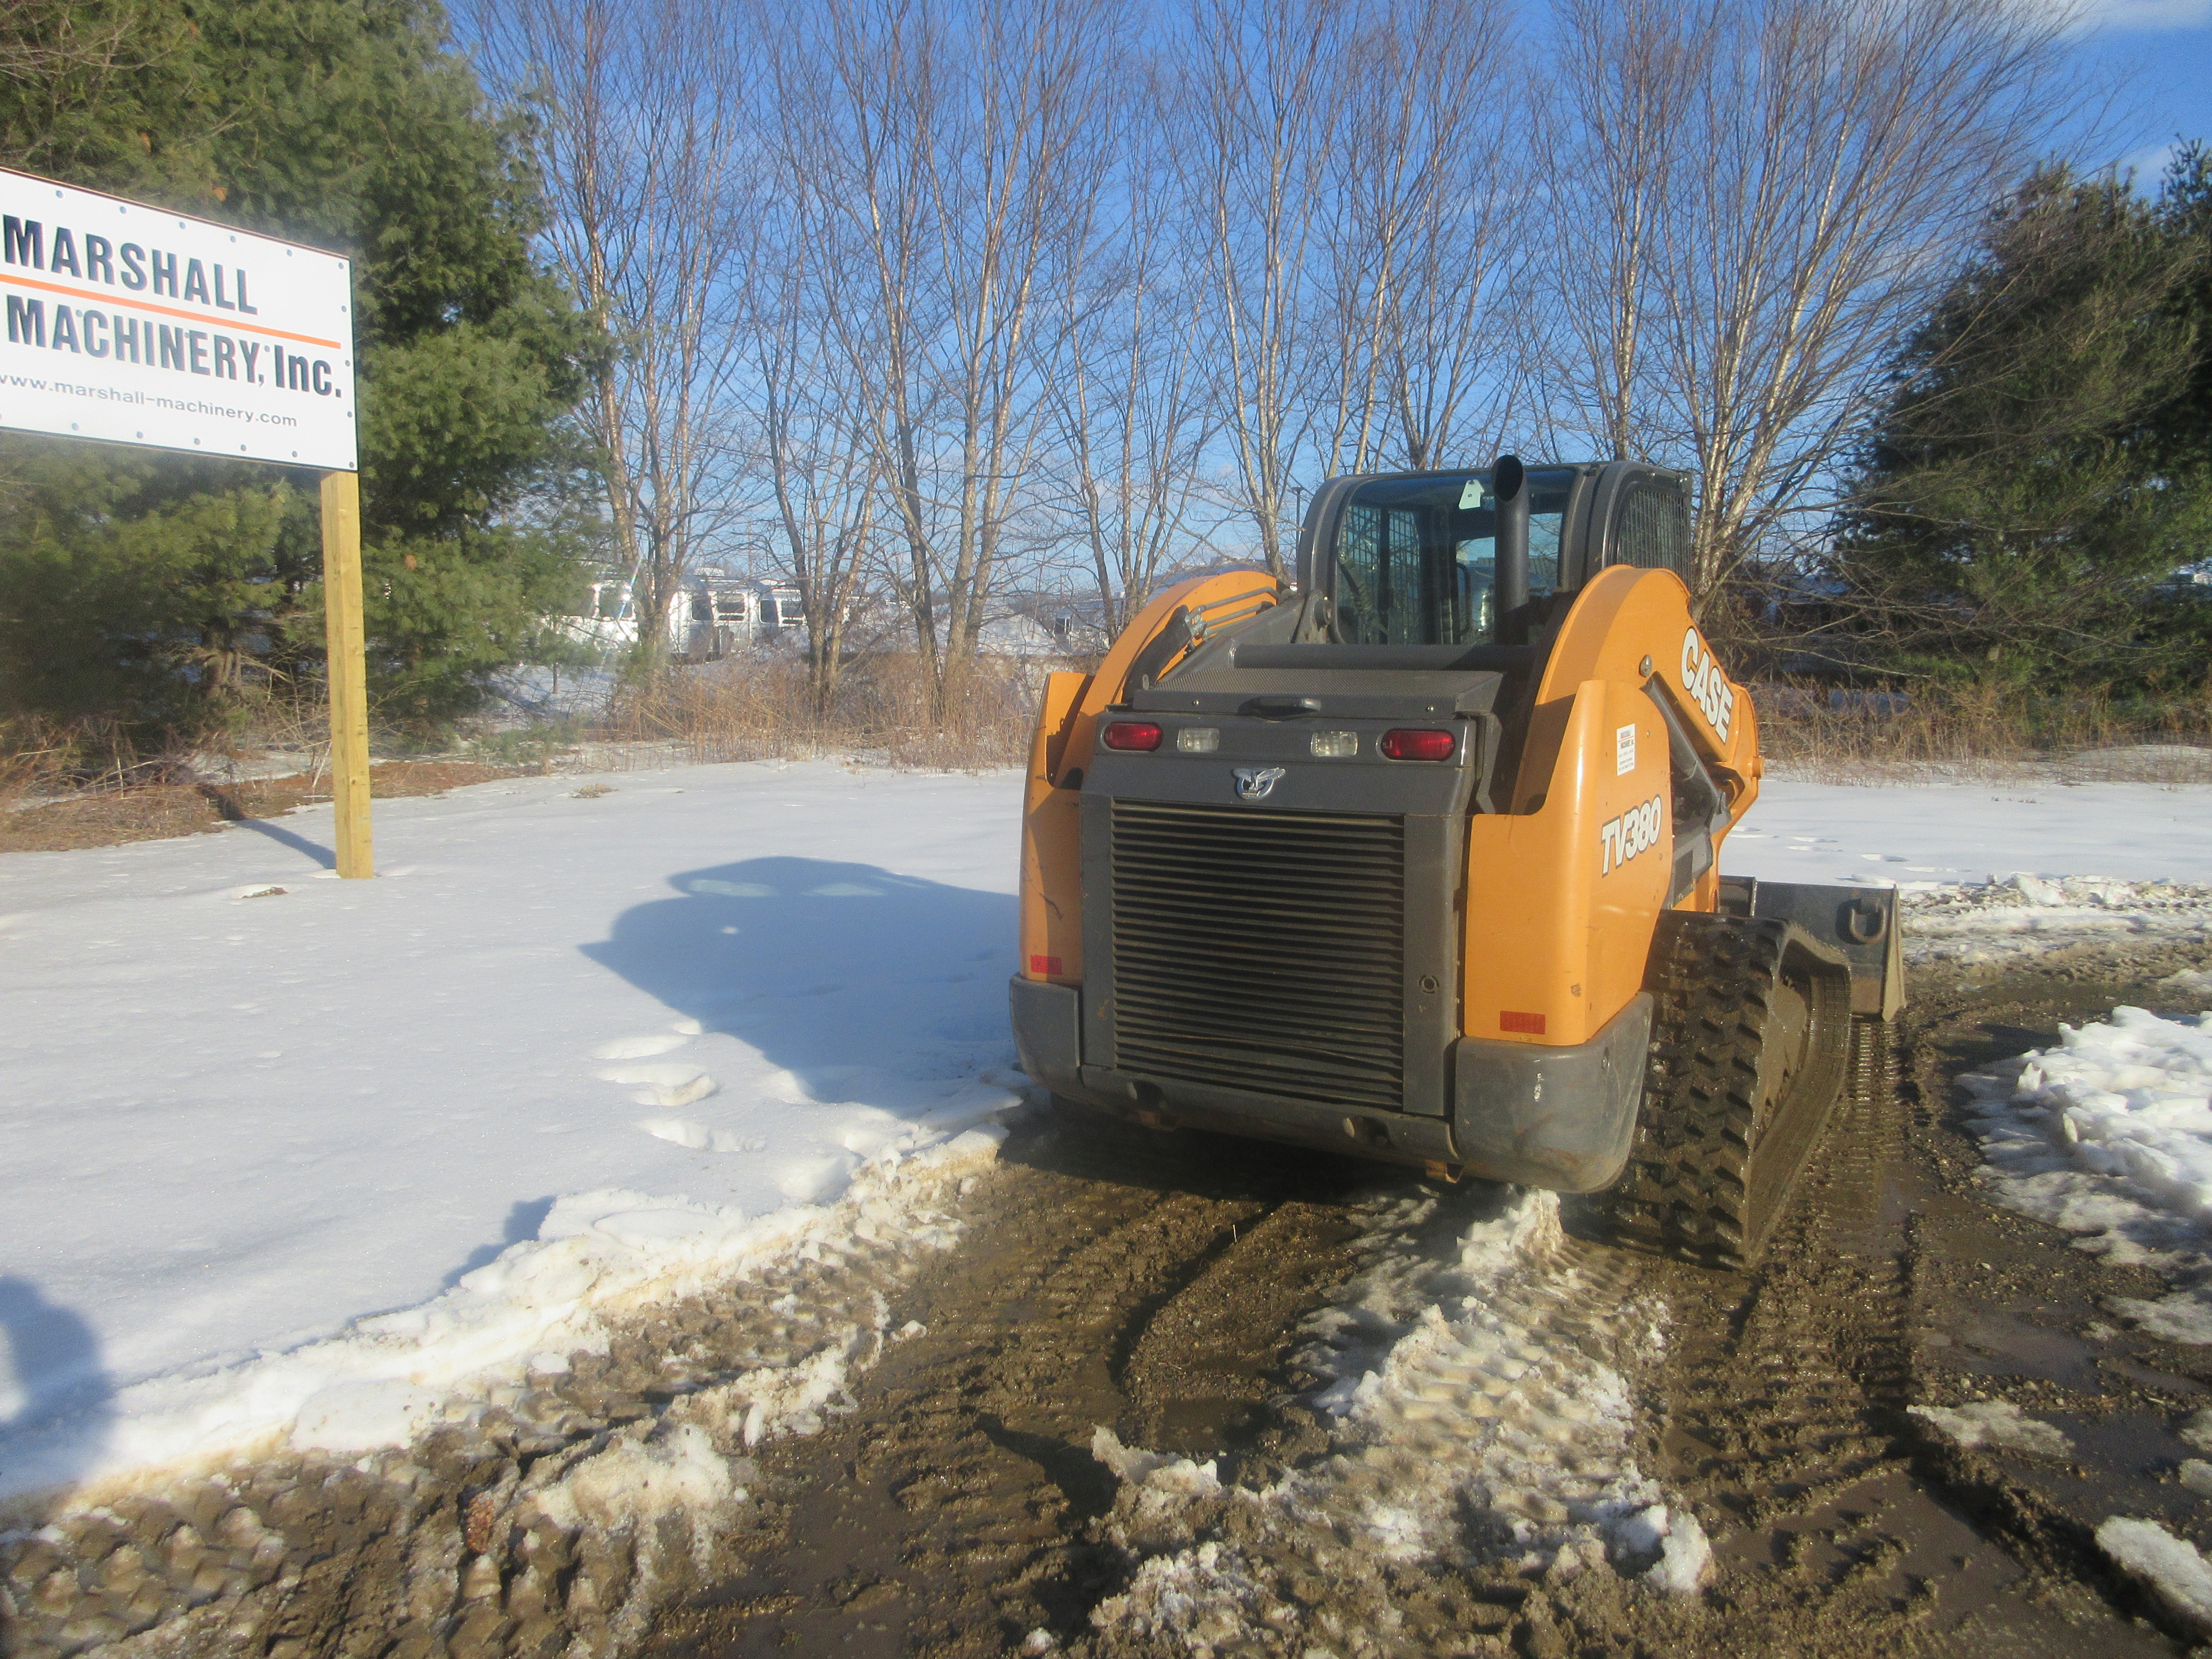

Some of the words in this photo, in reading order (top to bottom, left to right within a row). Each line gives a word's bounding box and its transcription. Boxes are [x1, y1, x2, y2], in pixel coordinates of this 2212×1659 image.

[3, 214, 258, 315] MARSHALL
[6, 294, 265, 388] MACHINERY,
[274, 344, 342, 398] Inc.
[1681, 626, 1733, 744] CASE
[1601, 794, 1661, 876] TV380
